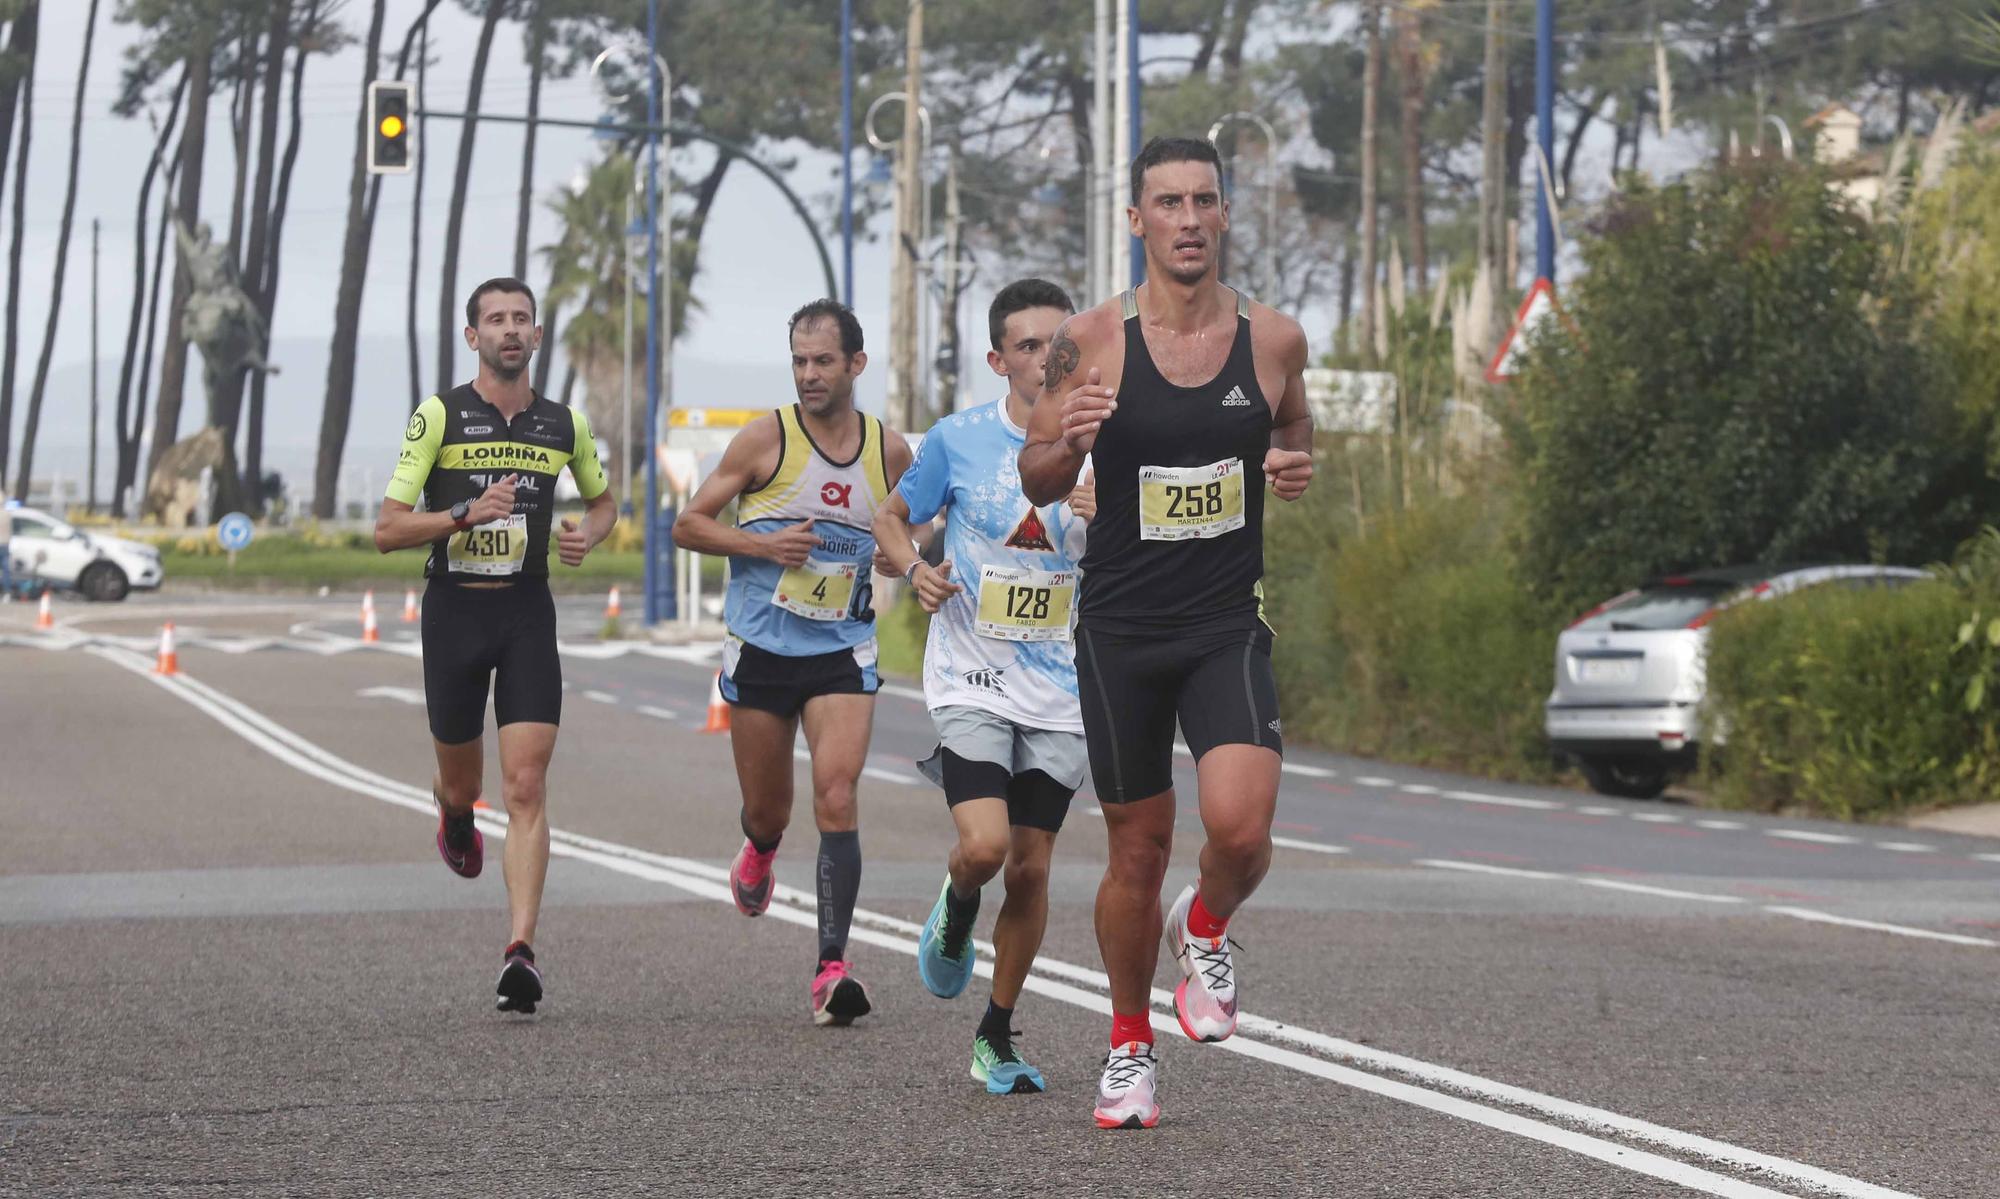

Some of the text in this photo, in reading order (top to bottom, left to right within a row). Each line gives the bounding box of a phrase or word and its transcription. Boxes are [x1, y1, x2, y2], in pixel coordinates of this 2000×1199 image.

[1222, 398, 1251, 407] adidas
[463, 446, 550, 464] LOURIÑA
[1153, 472, 1180, 480] howden
[1217, 463, 1229, 477] 21
[1165, 481, 1223, 518] 258
[1177, 517, 1214, 525] MARTIN44
[464, 529, 510, 557] 430
[816, 541, 857, 556] BOIRO
[995, 572, 1019, 580] howden
[1054, 574, 1065, 585] 21
[812, 576, 827, 601] 4
[1006, 586, 1051, 619] 128
[820, 854, 837, 939] kalenji
